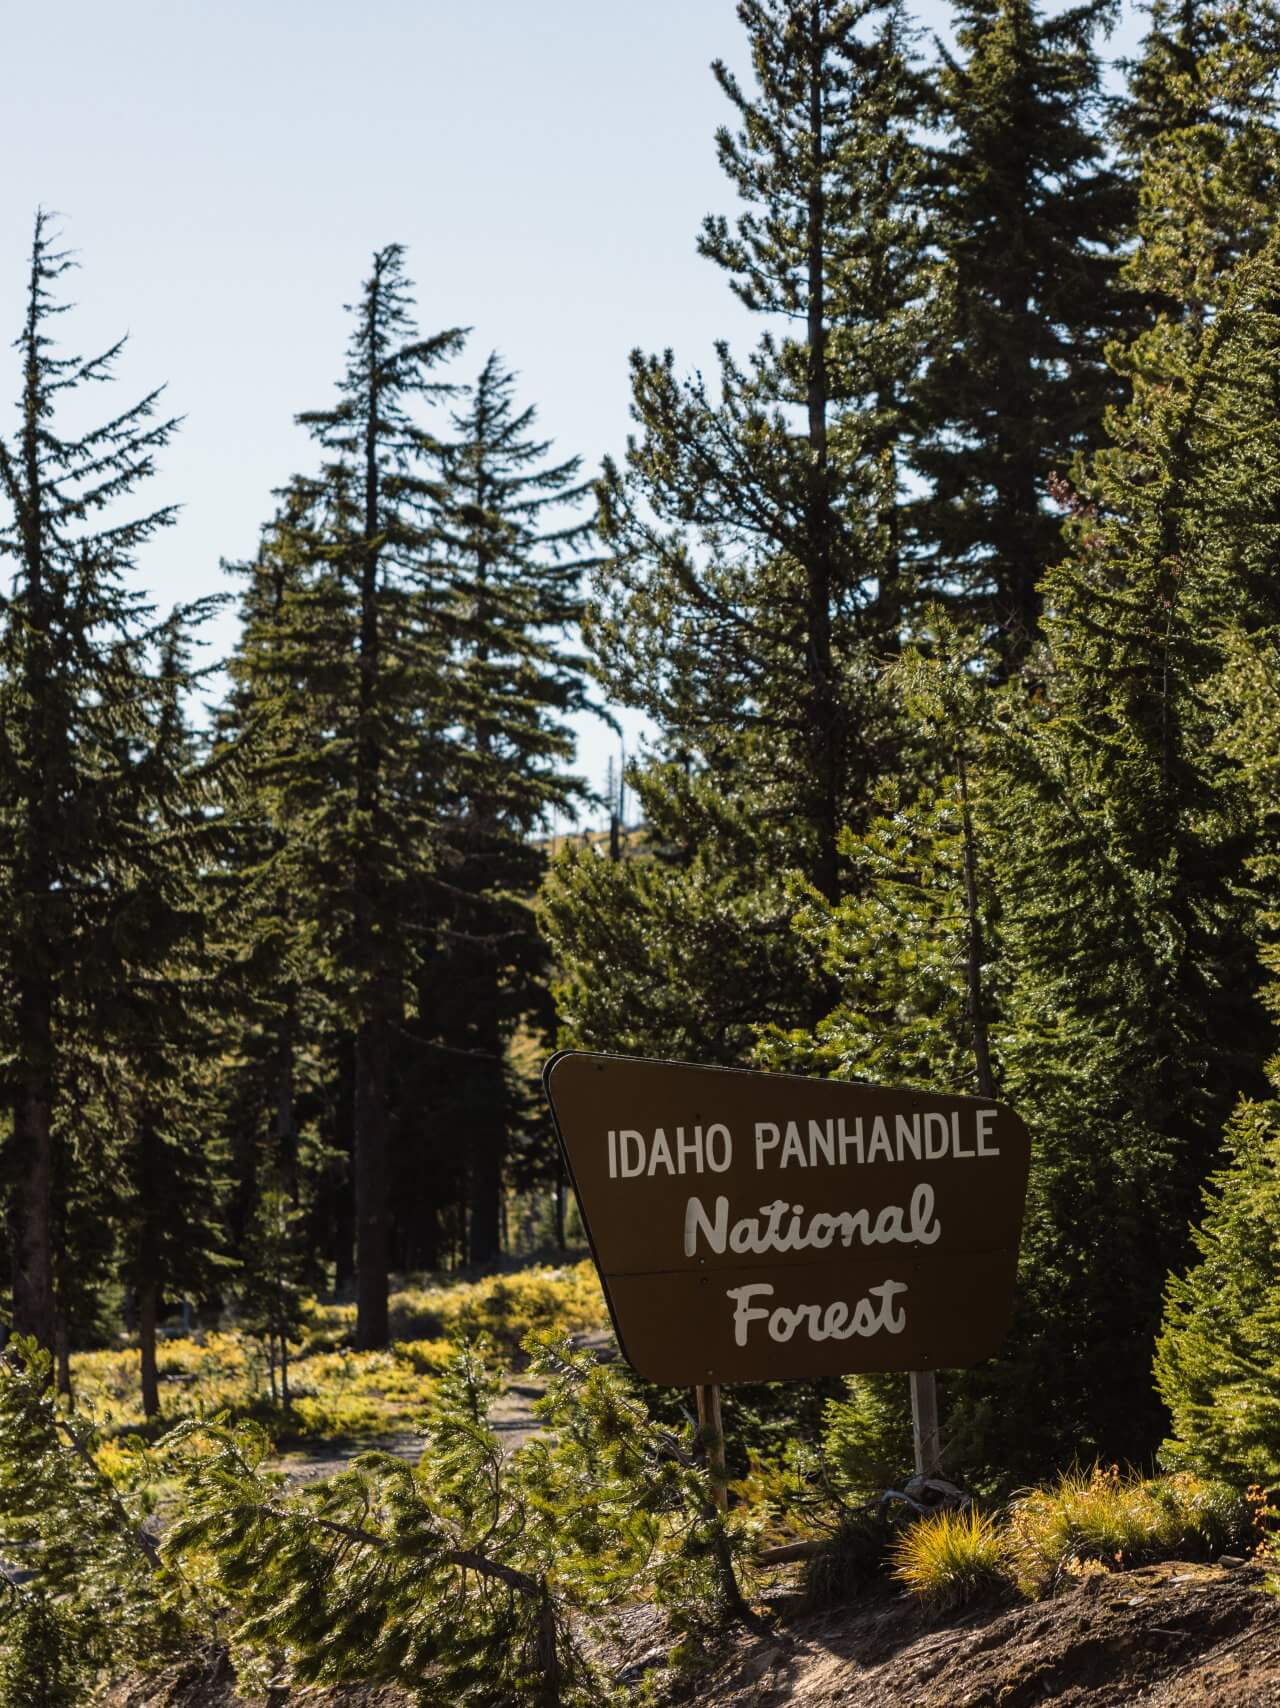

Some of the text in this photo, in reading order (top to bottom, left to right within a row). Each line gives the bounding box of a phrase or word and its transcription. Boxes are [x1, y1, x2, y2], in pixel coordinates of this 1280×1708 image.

[607, 1109, 1000, 1179] IDAHO PANHANDLE
[684, 1183, 941, 1257] National
[726, 1279, 909, 1347] Forest
